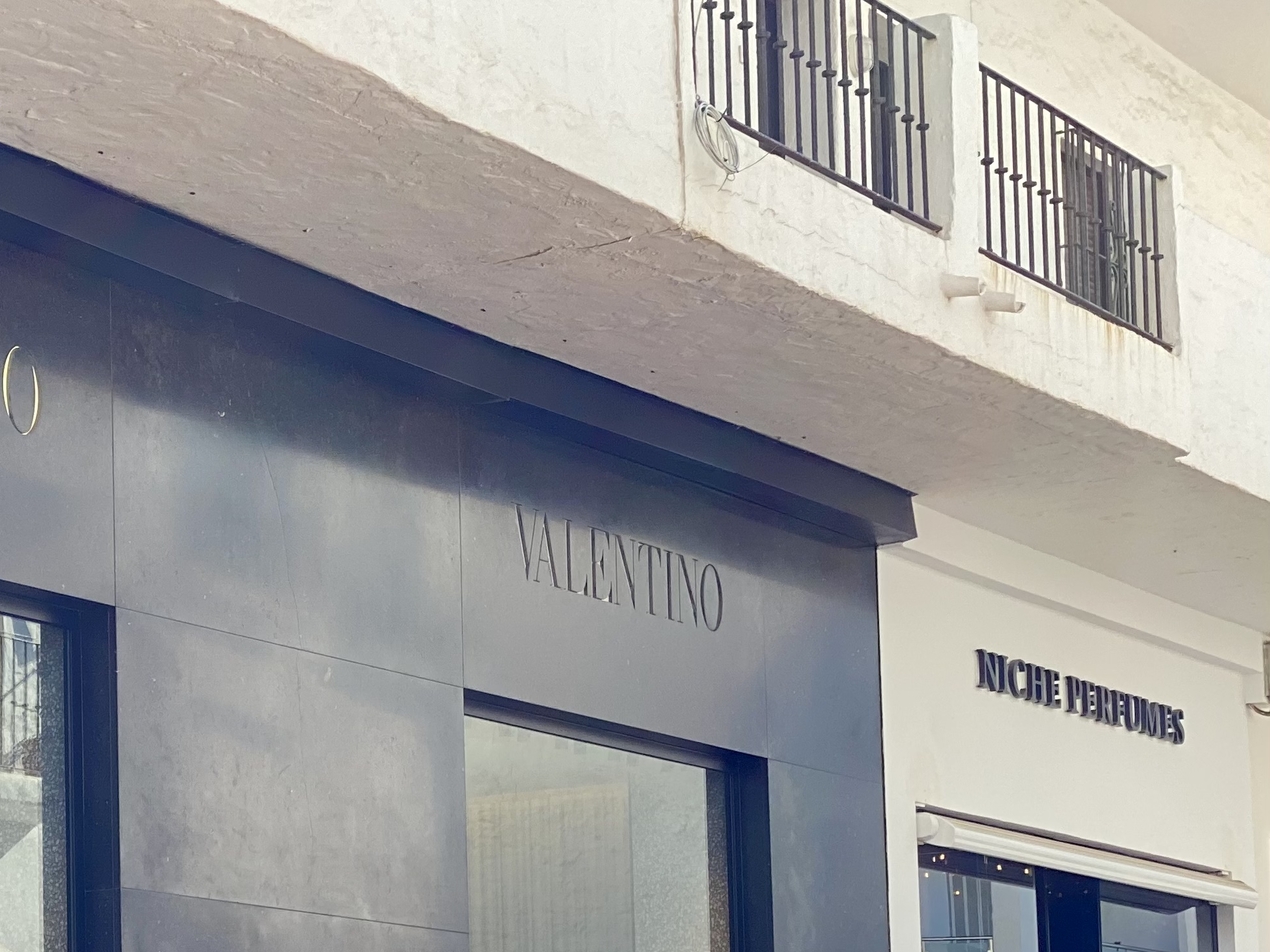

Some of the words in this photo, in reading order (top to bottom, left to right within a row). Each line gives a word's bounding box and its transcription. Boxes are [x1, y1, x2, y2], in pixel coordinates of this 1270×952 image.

[511, 502, 723, 632] VALENTINO
[974, 648, 1061, 709] NICHE
[1064, 675, 1185, 745] PERFUMES
